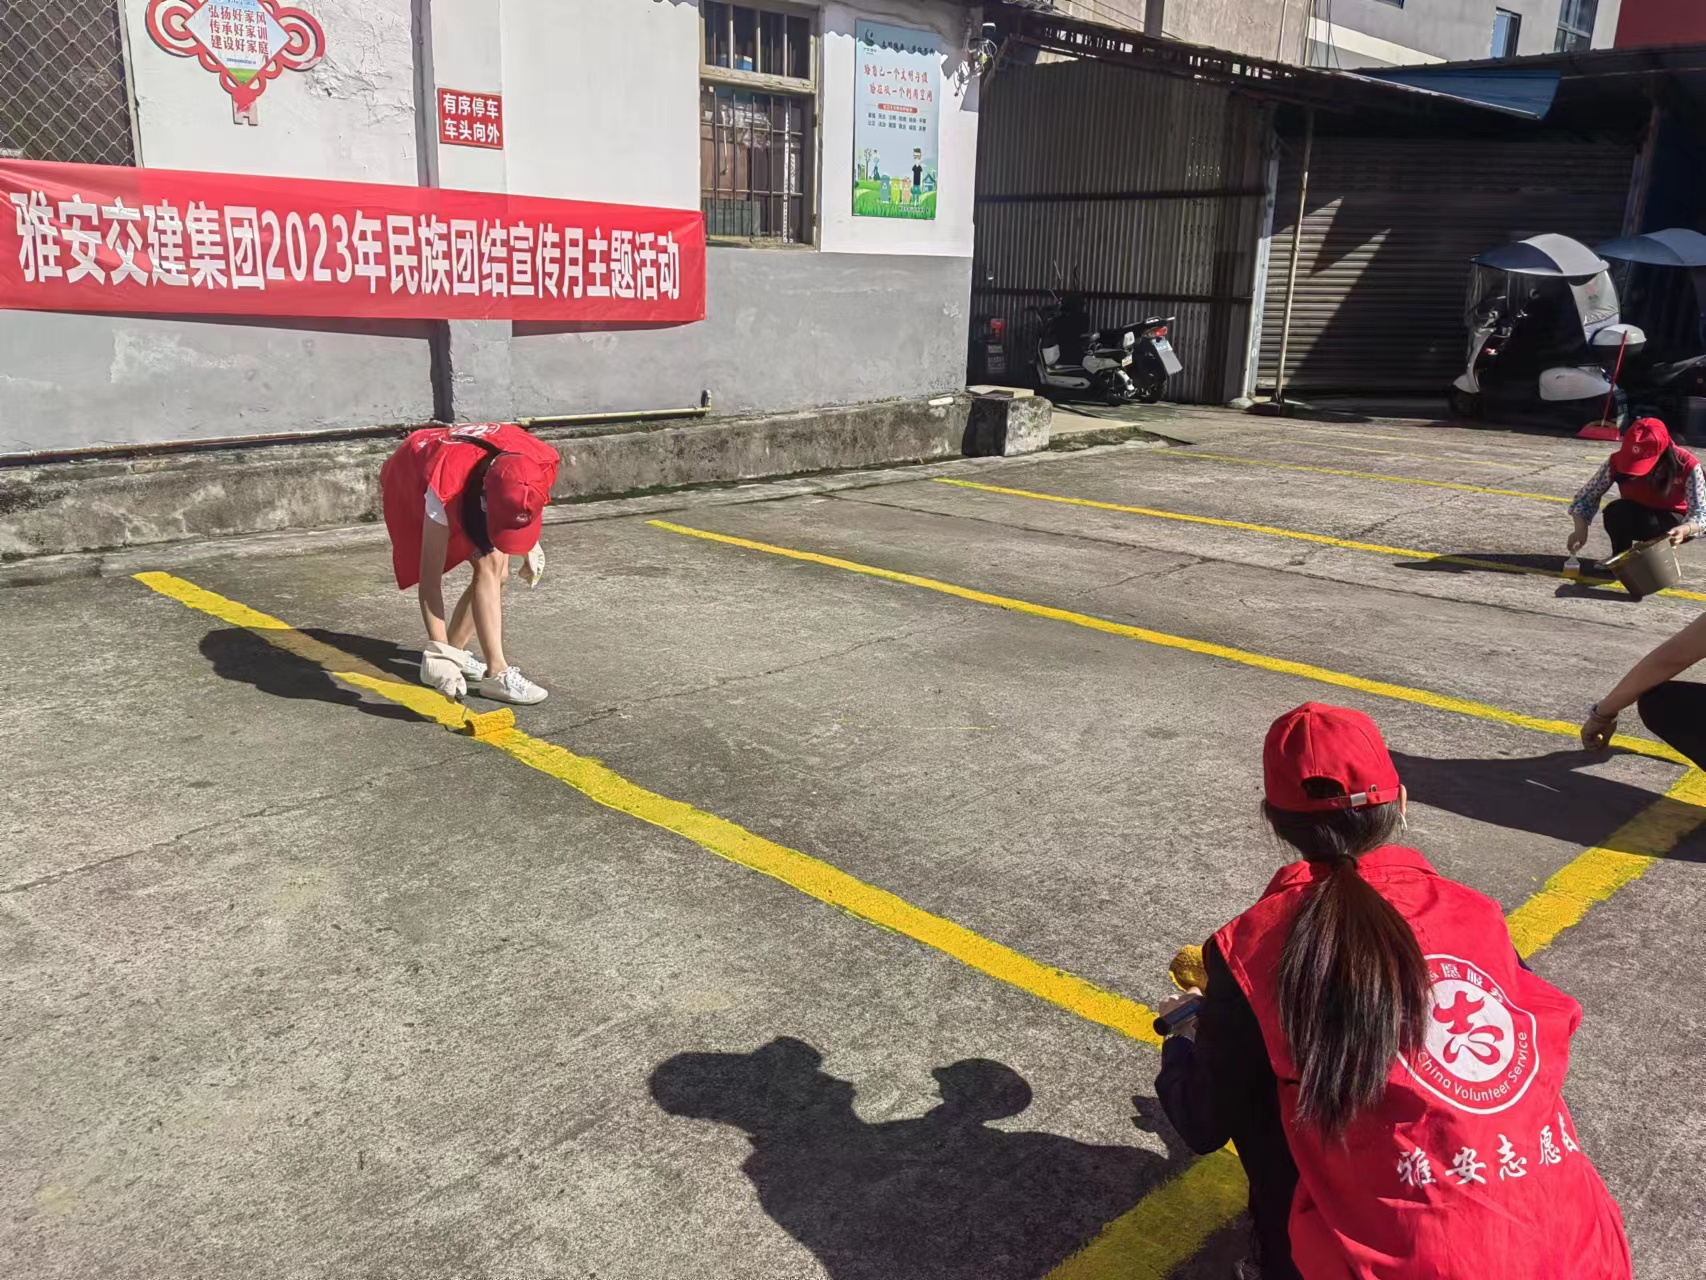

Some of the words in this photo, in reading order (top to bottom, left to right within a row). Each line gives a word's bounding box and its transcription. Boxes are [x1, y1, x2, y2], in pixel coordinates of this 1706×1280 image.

[208, 4, 267, 25] 弘扬好家风
[210, 19, 268, 41] 传承好家训
[211, 35, 269, 55] 建设好家庭
[443, 93, 499, 119] 有序停车
[444, 118, 500, 144] 车头向外
[9, 189, 681, 301] 雅安交建集团2023年民族团结宣传月主题活动
[1417, 1051, 1452, 1088] China
[1454, 1080, 1511, 1102] Volunteer
[1507, 1031, 1528, 1083] Service
